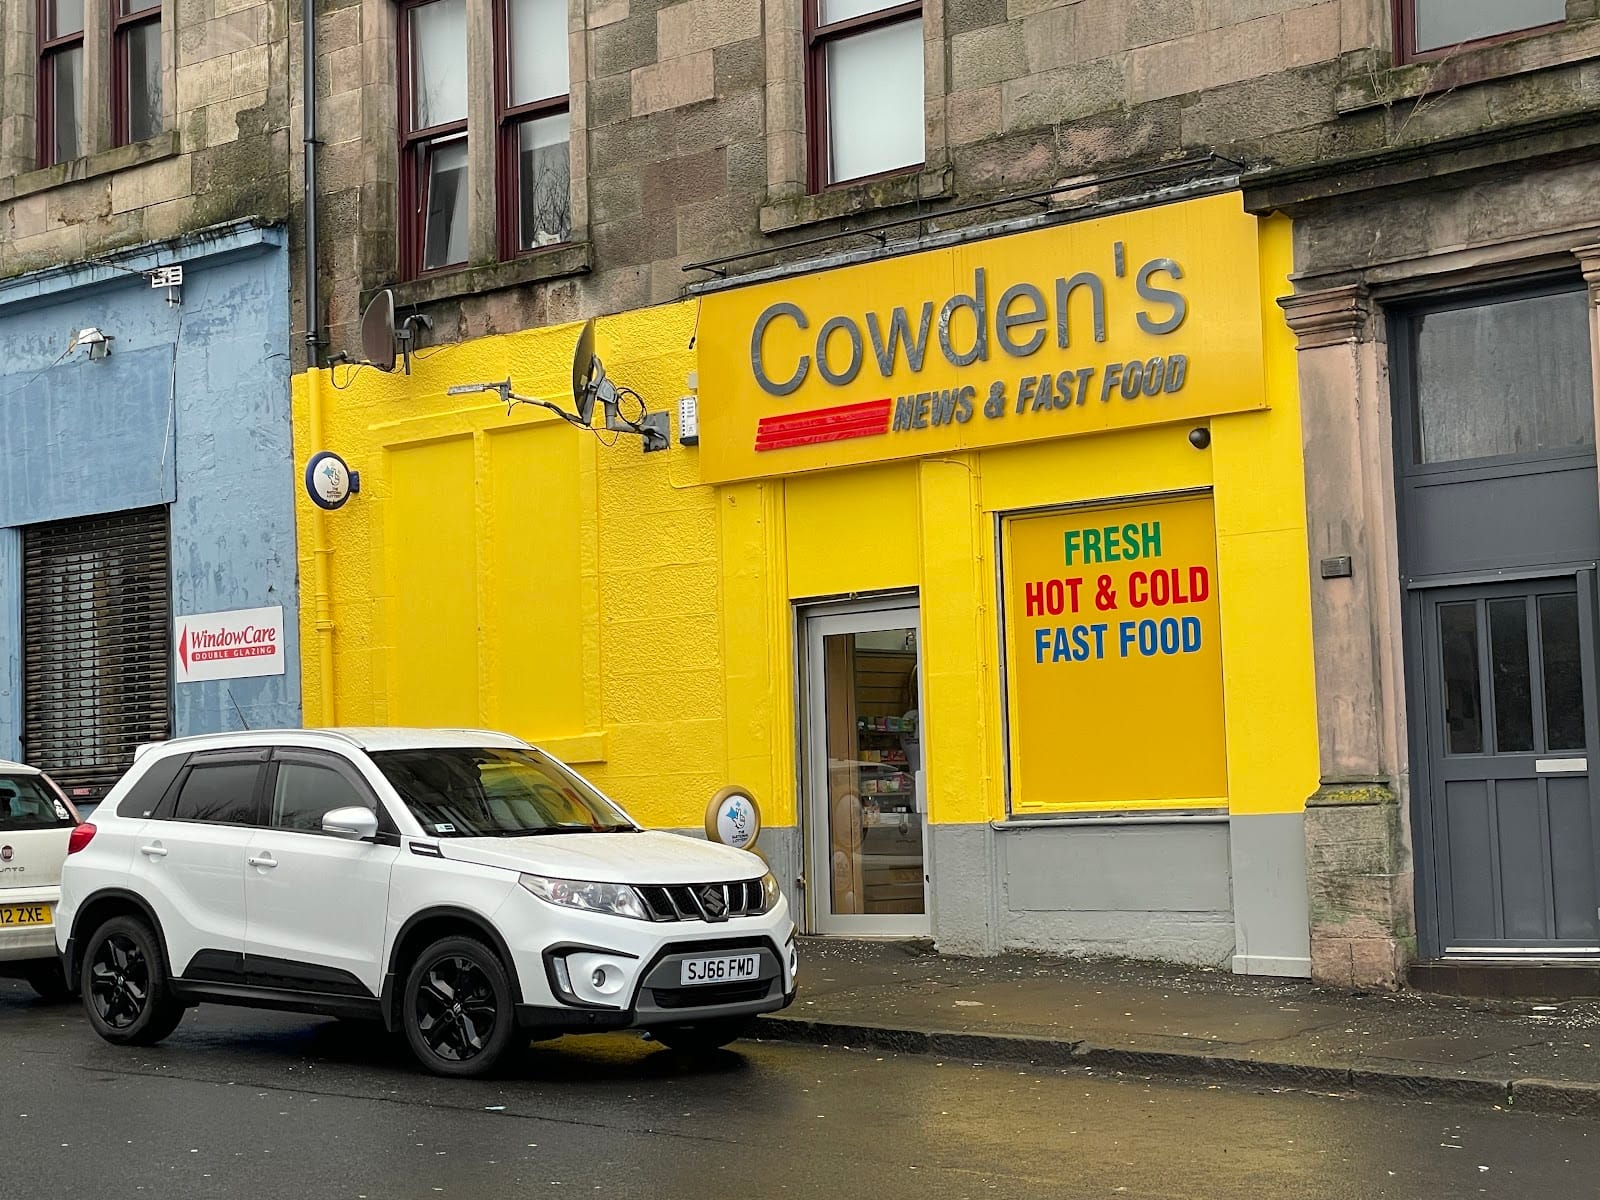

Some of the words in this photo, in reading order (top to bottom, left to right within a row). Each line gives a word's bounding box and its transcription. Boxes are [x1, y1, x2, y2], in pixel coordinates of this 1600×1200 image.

[751, 241, 1187, 397] Cowden's
[892, 385, 976, 432] NEWS
[983, 380, 1005, 419] &
[1015, 367, 1095, 414] FAST
[1100, 353, 1187, 402] FOOD
[1064, 521, 1162, 566] FRESH
[1025, 577, 1083, 617] HOT
[1095, 574, 1118, 611] &
[1128, 566, 1209, 608] COLD
[191, 625, 276, 649] WindowCare
[195, 650, 228, 661] DOUBLE
[233, 646, 272, 657] GLAZING
[1035, 623, 1108, 664] FAST
[1119, 616, 1202, 658] FOOD
[16, 907, 44, 922] ZXE
[688, 960, 725, 980] SJ66
[728, 957, 754, 976] FMD
